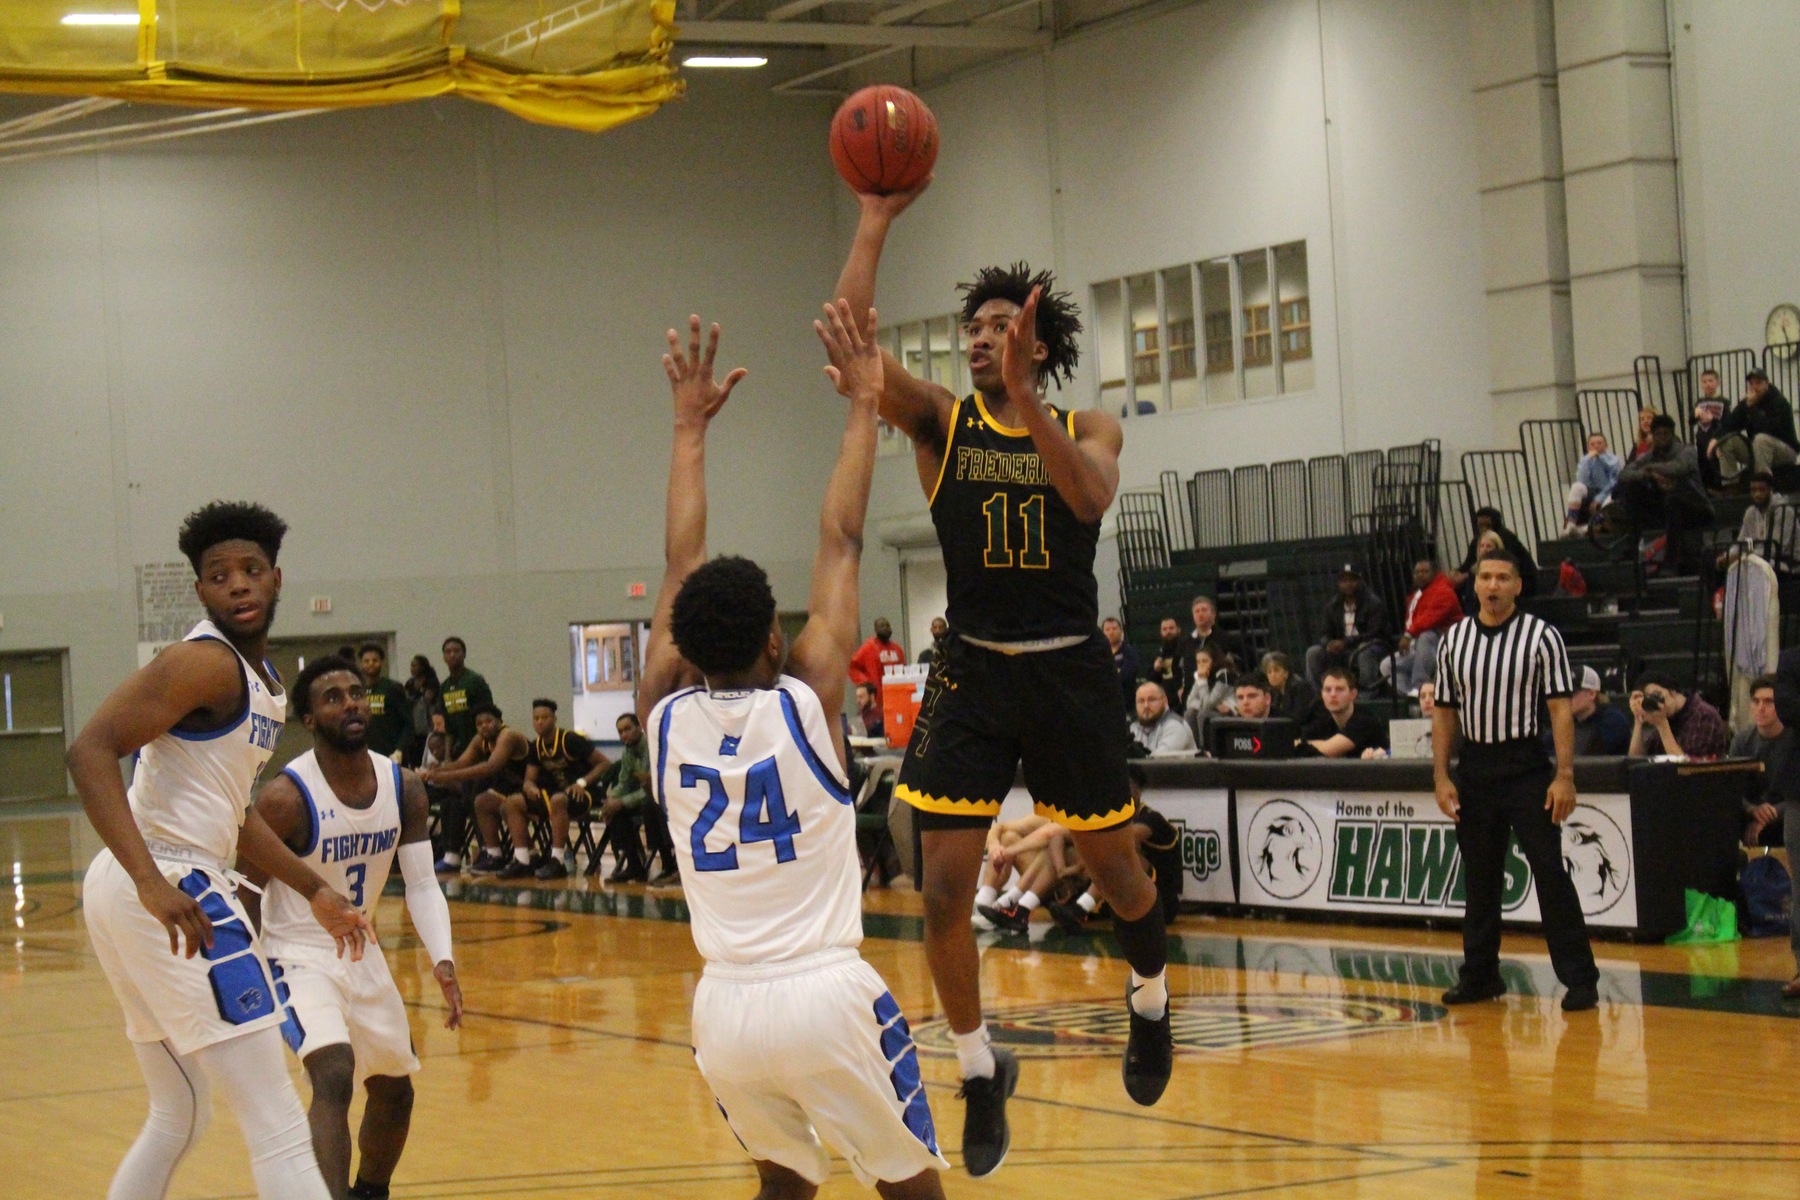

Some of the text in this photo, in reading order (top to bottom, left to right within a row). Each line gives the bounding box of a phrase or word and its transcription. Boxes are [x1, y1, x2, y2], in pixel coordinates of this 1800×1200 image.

[983, 492, 1049, 569] 11
[680, 755, 802, 872] 24
[1335, 801, 1414, 817] Home of the
[321, 827, 398, 863] FIGHTING
[1328, 819, 1533, 912] HAWS
[345, 862, 367, 907] 3
